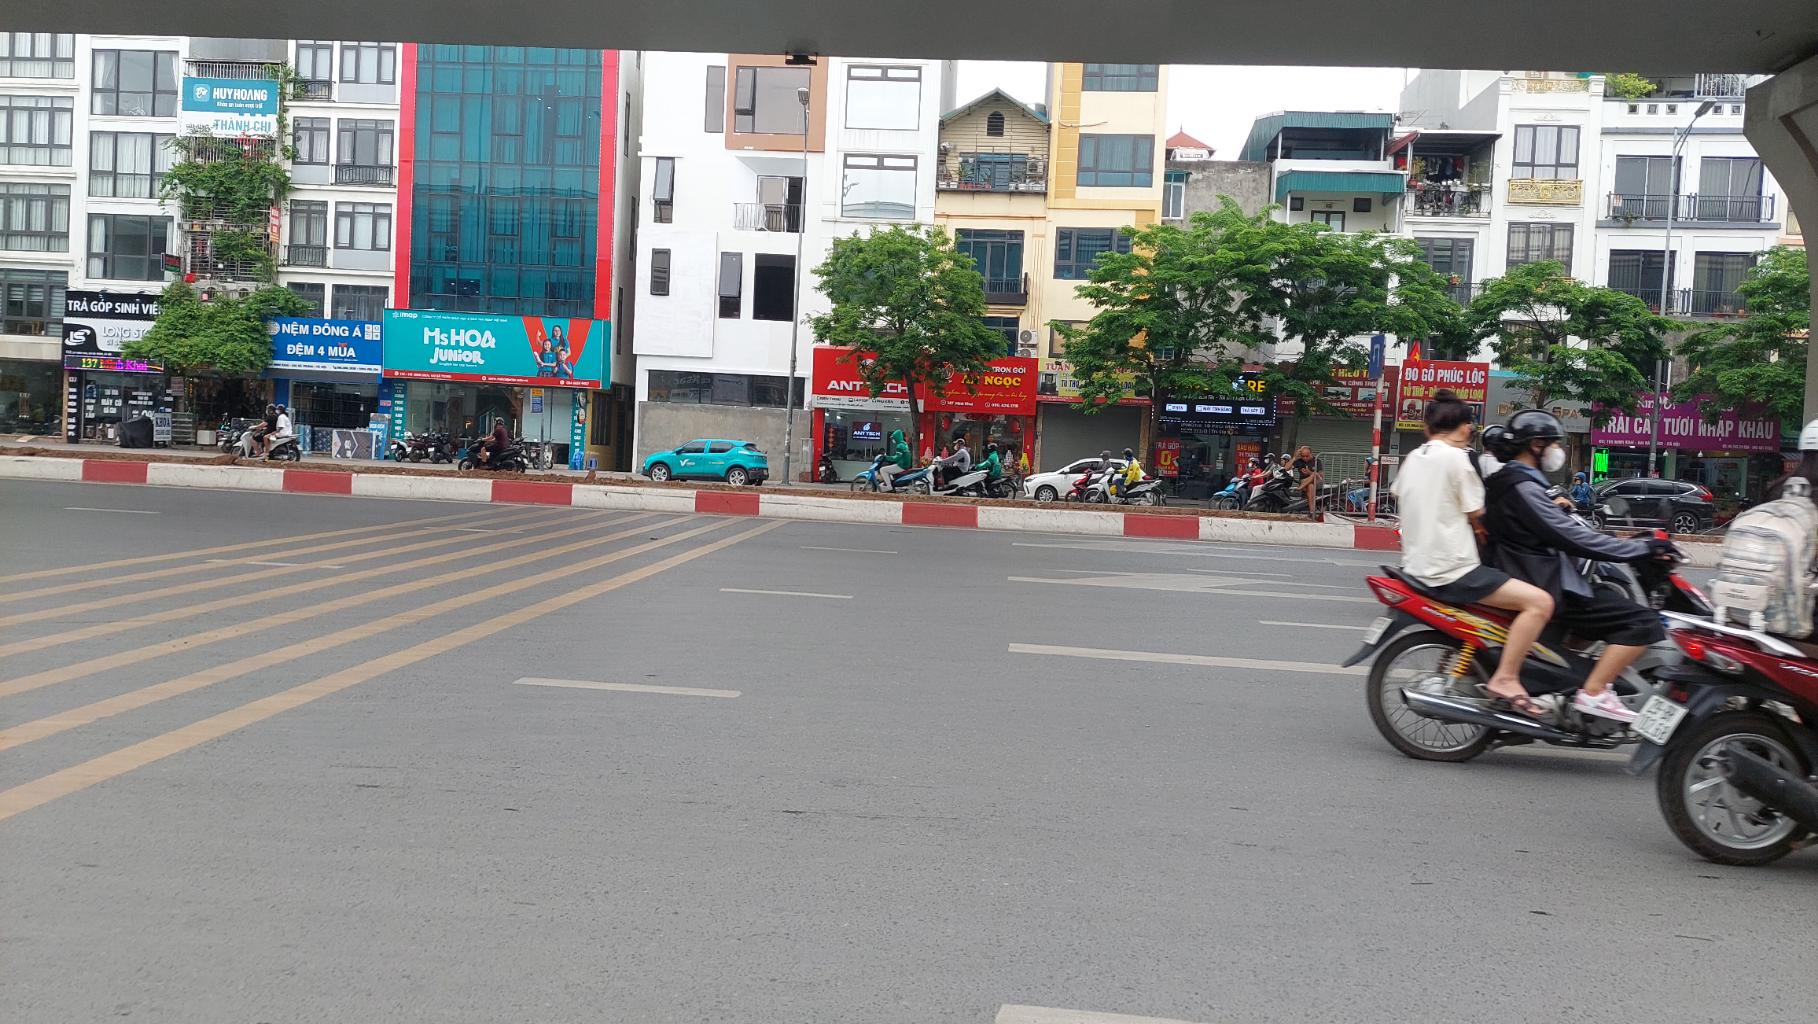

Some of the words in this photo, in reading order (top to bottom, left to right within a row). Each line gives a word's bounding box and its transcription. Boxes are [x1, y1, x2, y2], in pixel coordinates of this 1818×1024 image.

[212, 87, 268, 101] HUYHOANG
[67, 297, 89, 312] TRẢ
[90, 298, 113, 313] GÓP
[114, 301, 140, 315] SINH
[141, 300, 162, 315] VIÊ
[103, 326, 131, 339] LONG
[281, 321, 310, 337] NỆM
[312, 322, 350, 337] ĐÔNG
[351, 324, 362, 338] Á
[423, 326, 449, 346] Ms
[450, 328, 497, 348] HOA
[286, 342, 315, 357] ĐỆM
[317, 345, 326, 356] 4
[81, 358, 98, 368] 137
[1012, 365, 1026, 374] GÓI
[984, 375, 1021, 389] NGỌC
[1421, 363, 1435, 382] GỖ
[1436, 367, 1464, 384] PHÚC
[1465, 367, 1485, 387] LỘC
[827, 380, 864, 391] ANT
[1663, 416, 1694, 437] TƯƠI
[1697, 416, 1734, 442] NHẬP
